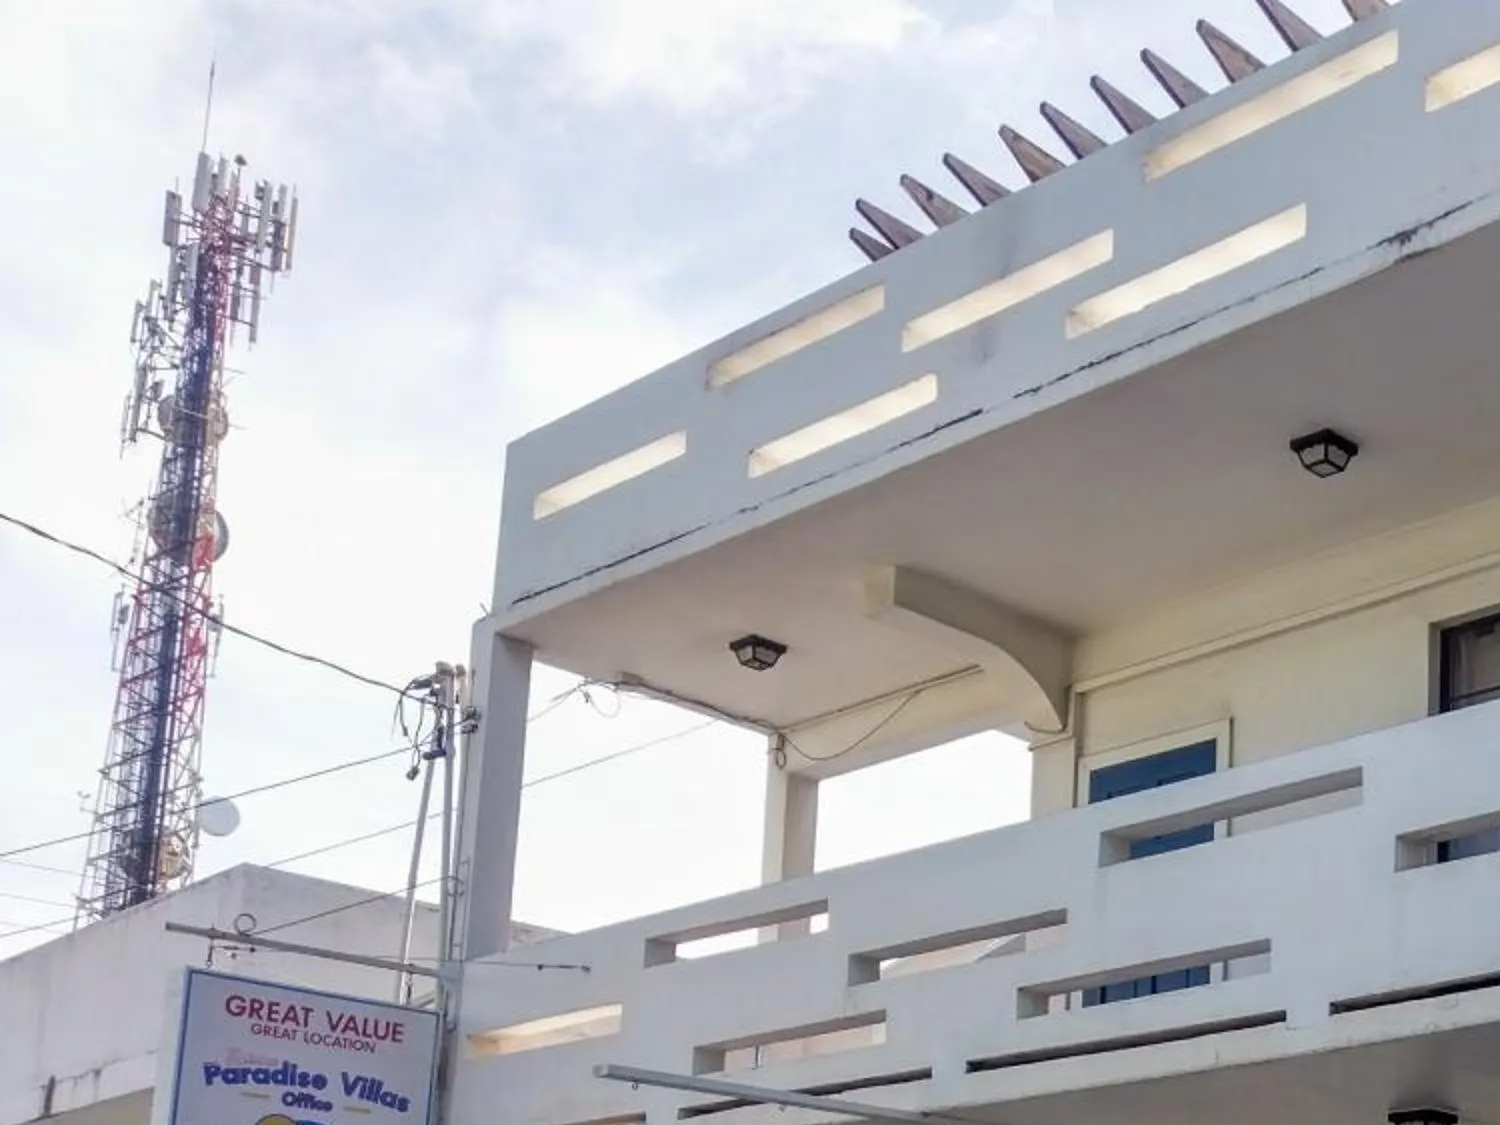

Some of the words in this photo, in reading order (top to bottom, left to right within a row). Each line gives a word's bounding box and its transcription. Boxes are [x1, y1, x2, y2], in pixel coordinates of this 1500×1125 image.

[225, 995, 314, 1028] GREAT
[325, 1009, 405, 1043] VALUE
[251, 1023, 299, 1041] GREAT
[303, 1032, 376, 1054] LOCATION
[203, 1061, 328, 1091] Paradise
[341, 1072, 411, 1113] Villas
[282, 1092, 333, 1113] Office
